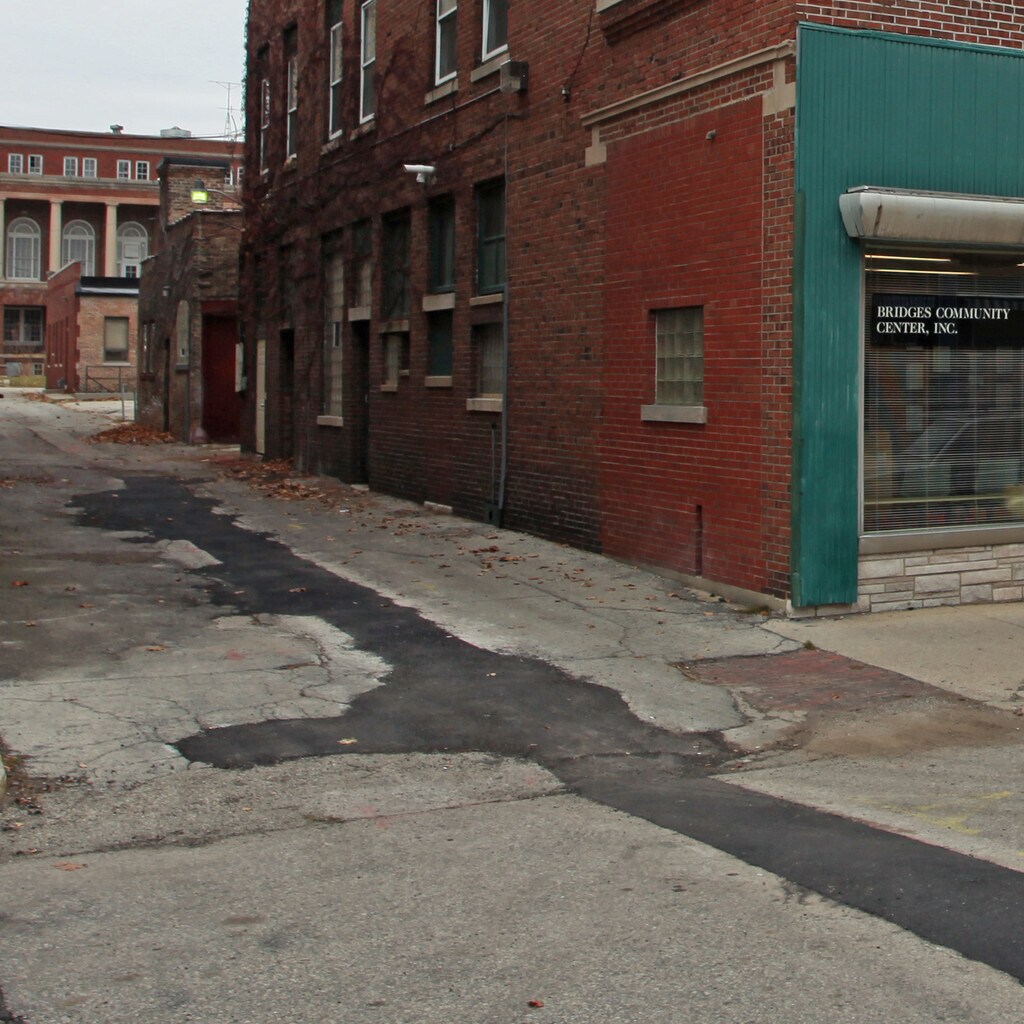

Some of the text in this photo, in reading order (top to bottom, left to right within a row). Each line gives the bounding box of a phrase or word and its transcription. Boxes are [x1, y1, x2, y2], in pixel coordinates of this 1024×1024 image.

[877, 306, 1011, 320] BRIDGES COMMUNITY
[876, 321, 959, 336] CENTER, INC.
